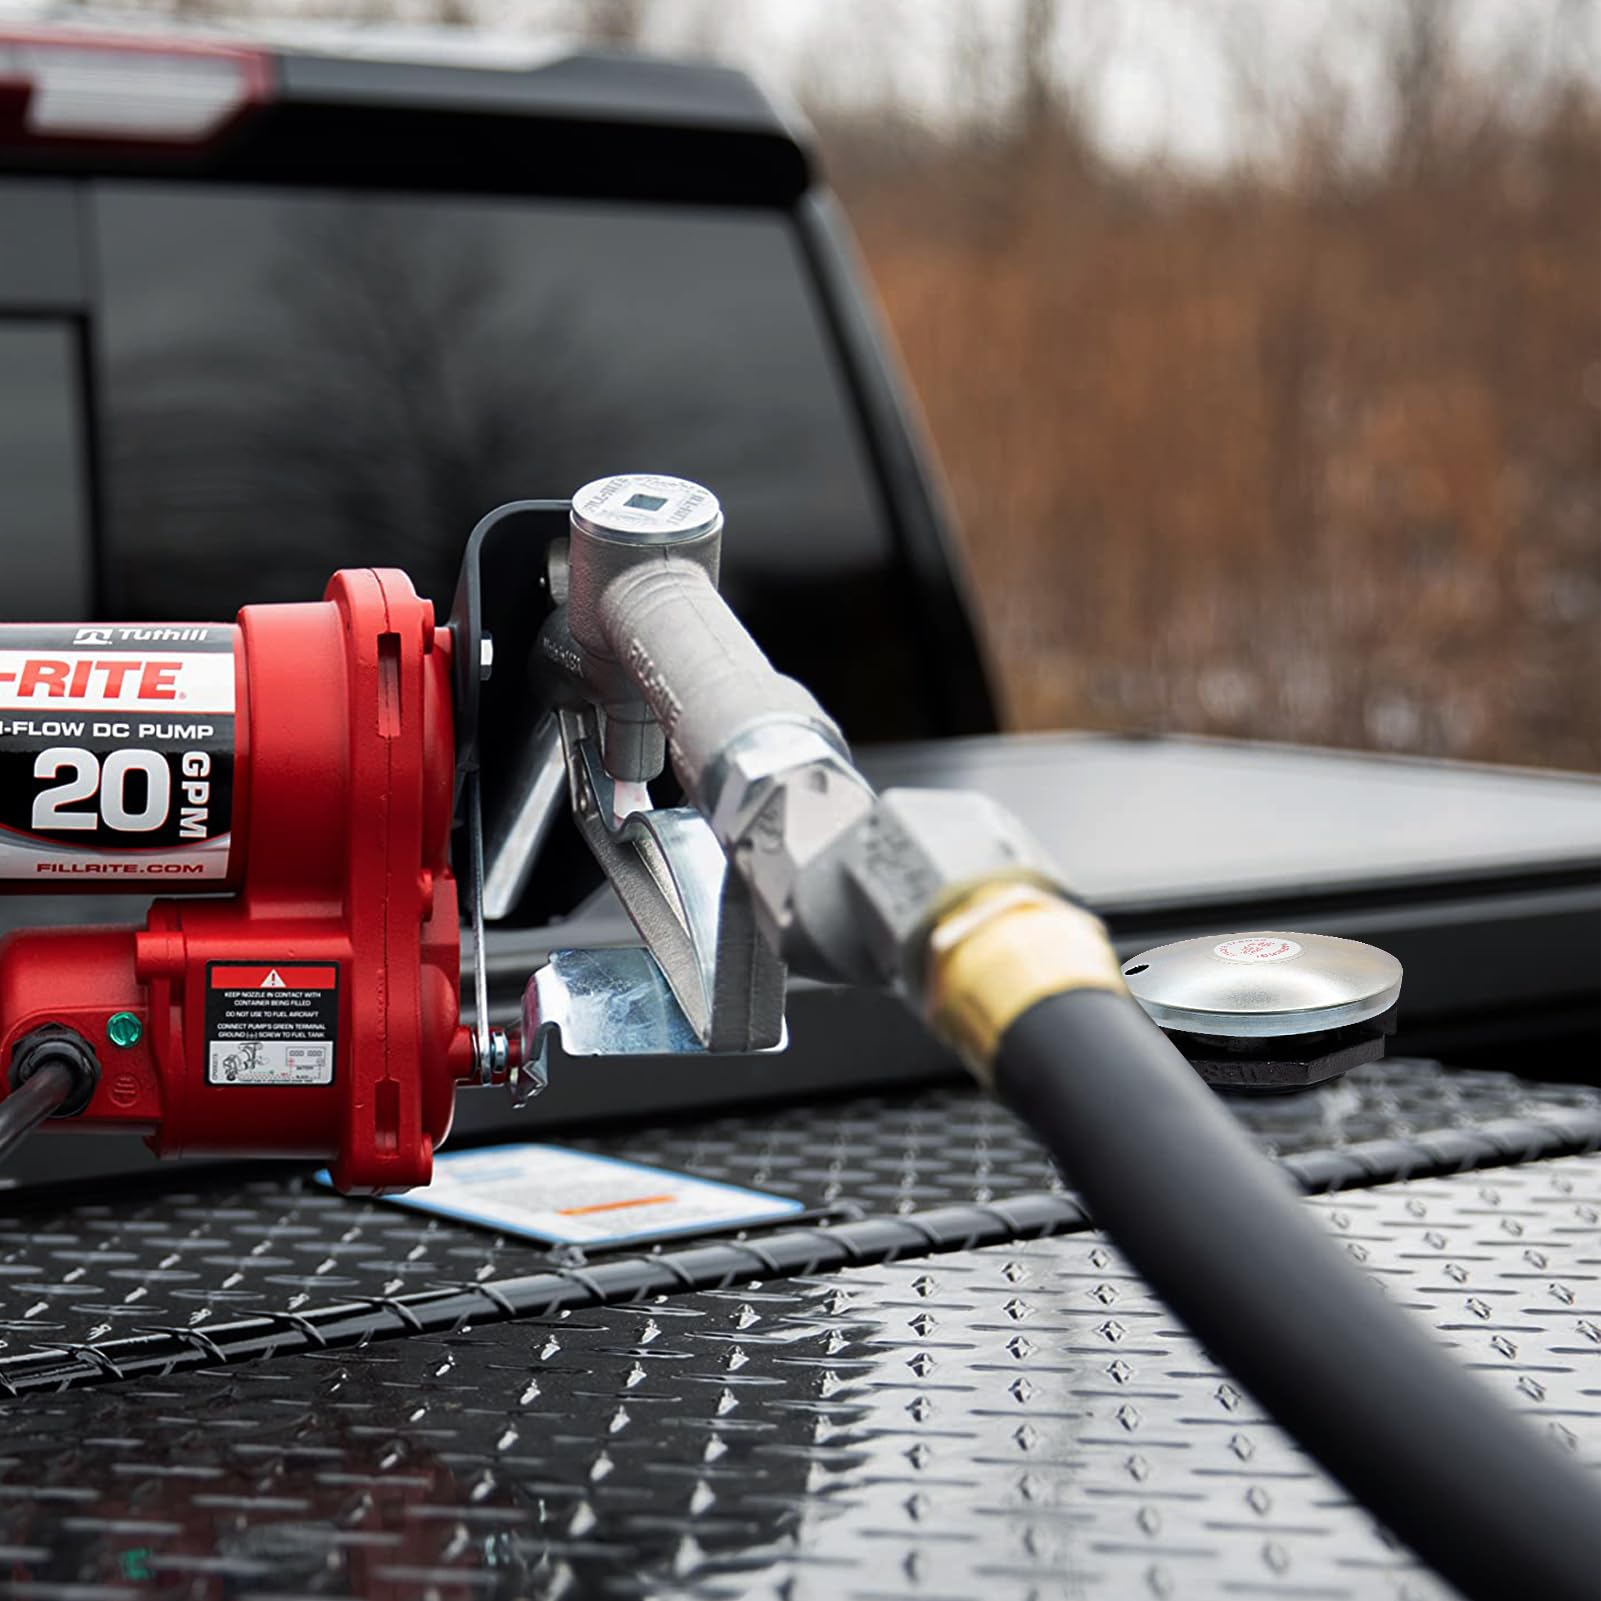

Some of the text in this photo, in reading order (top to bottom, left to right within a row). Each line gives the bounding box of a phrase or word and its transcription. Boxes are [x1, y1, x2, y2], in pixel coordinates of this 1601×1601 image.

[118, 628, 208, 641] Tuthill
[92, 722, 130, 738] DC
[138, 723, 214, 739] PUMP
[31, 746, 170, 832] 20
[179, 750, 211, 839] GPM
[36, 862, 204, 874] FILLRITE.COM
